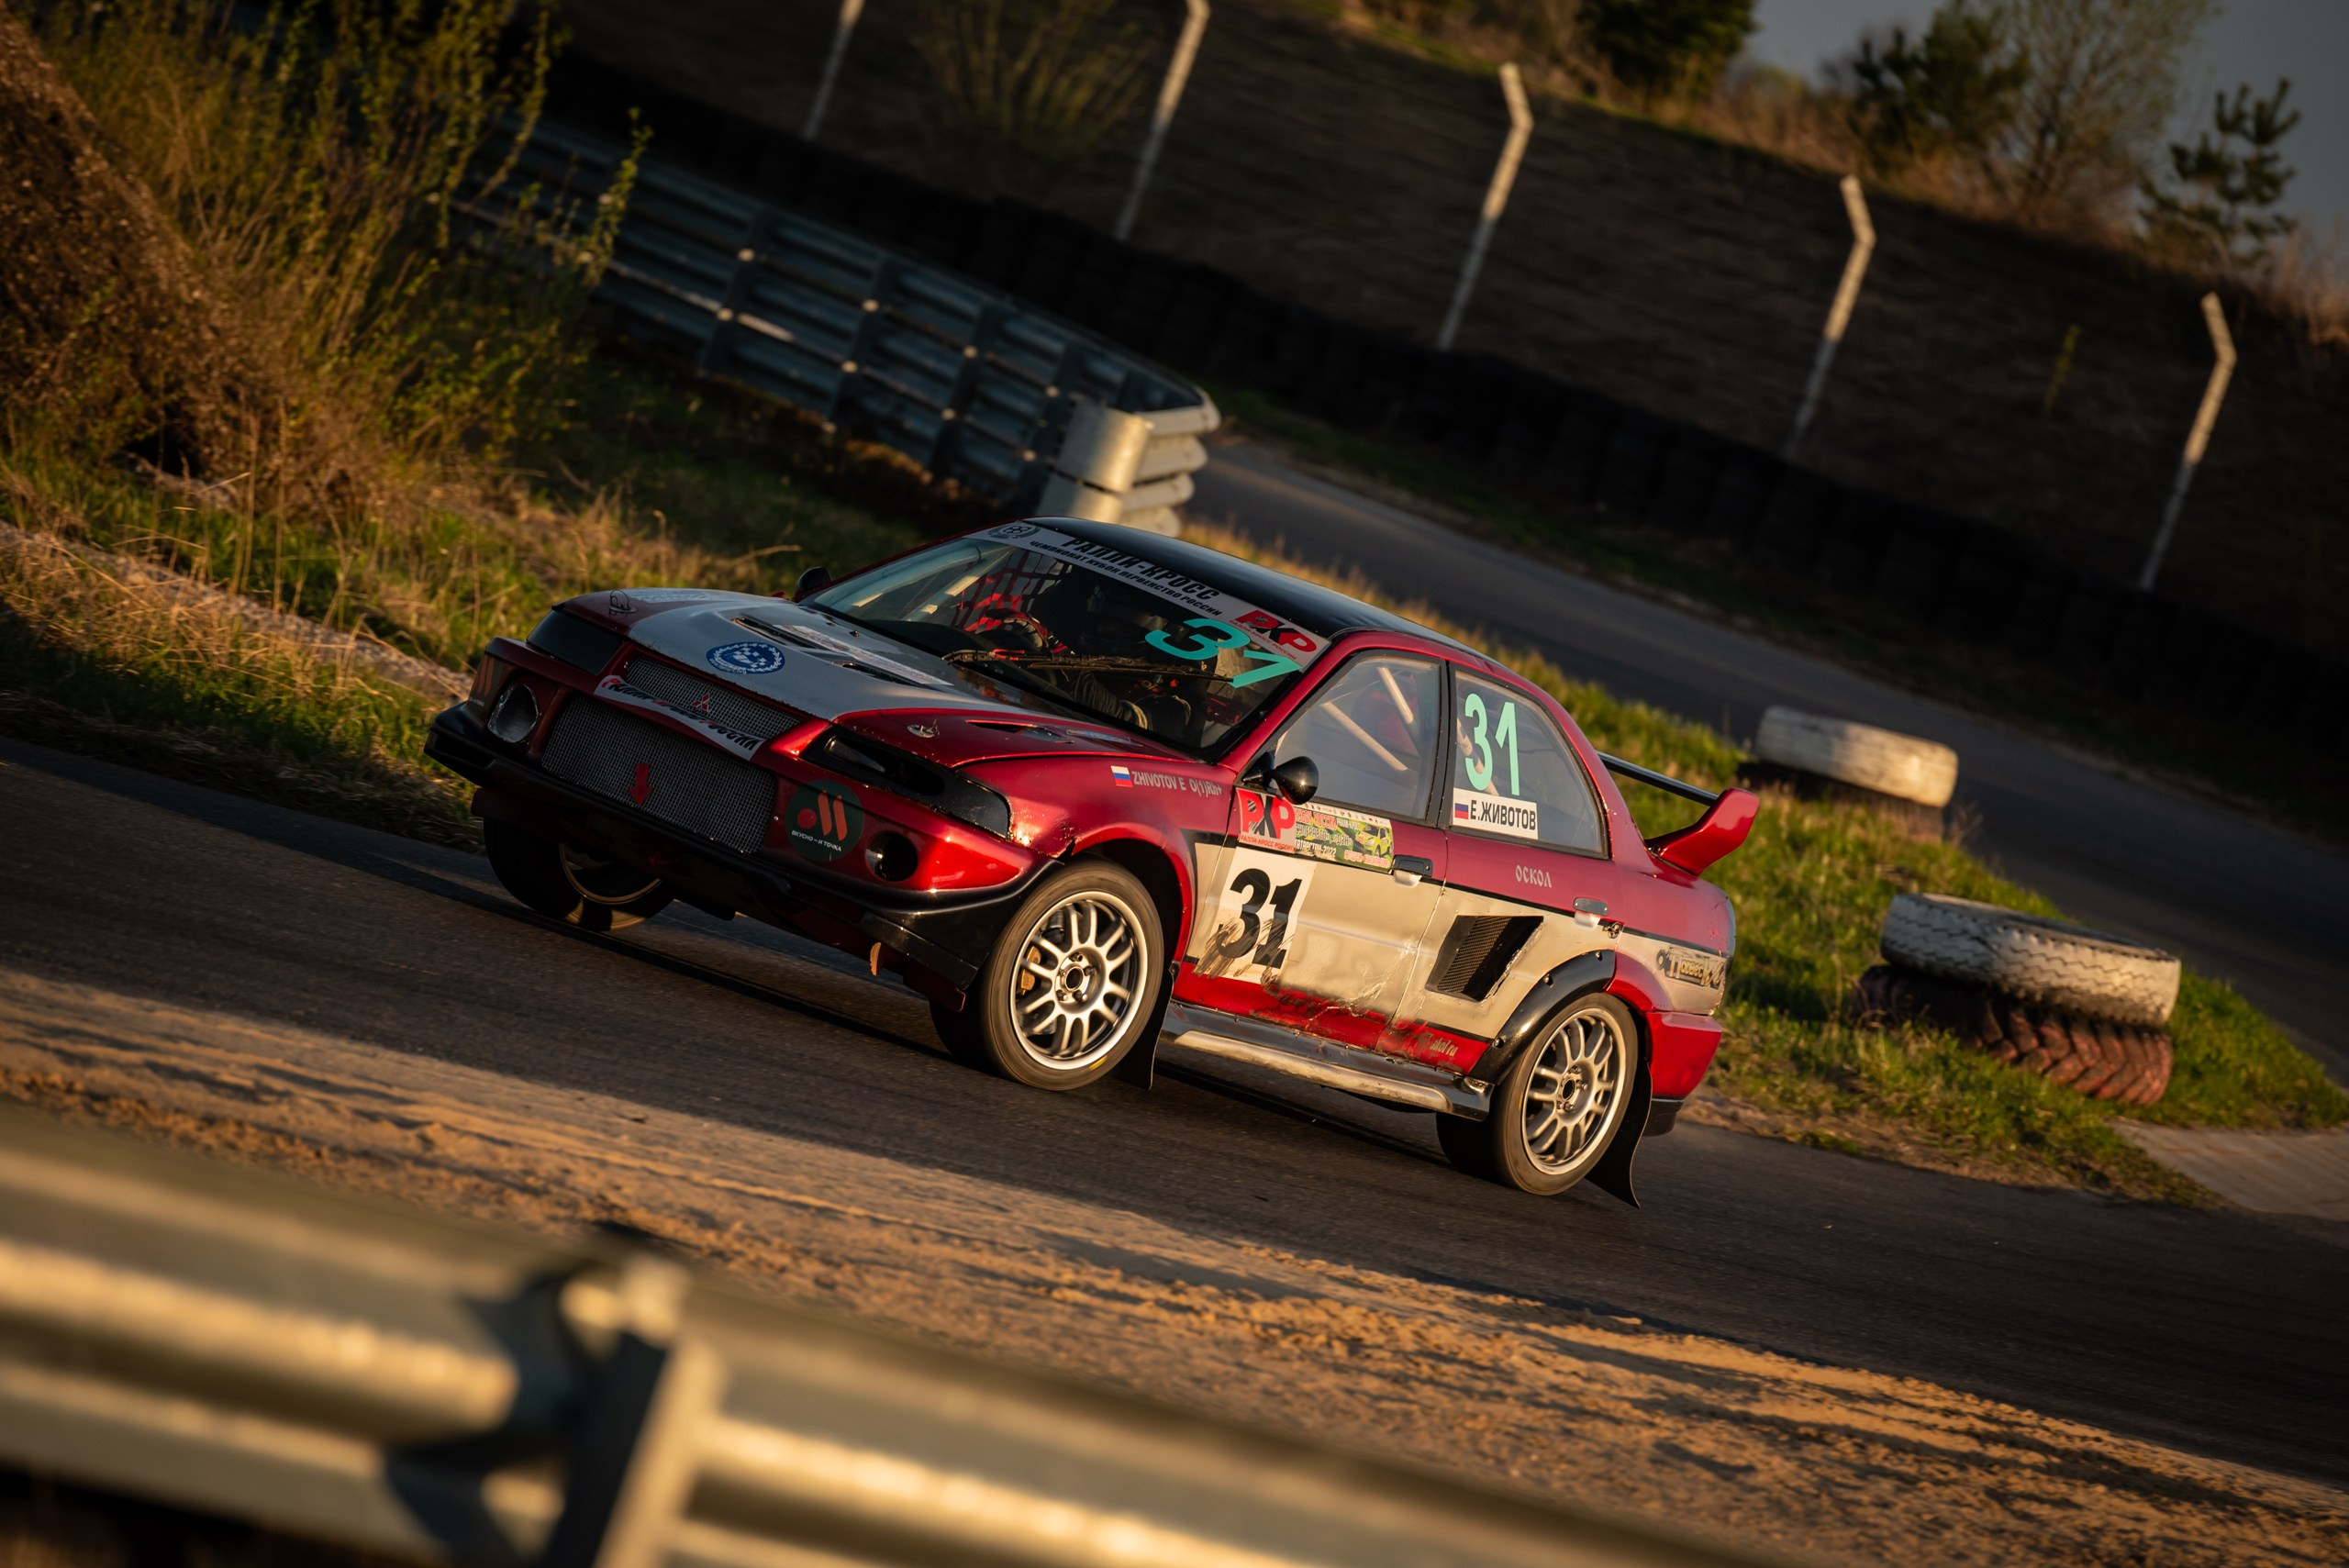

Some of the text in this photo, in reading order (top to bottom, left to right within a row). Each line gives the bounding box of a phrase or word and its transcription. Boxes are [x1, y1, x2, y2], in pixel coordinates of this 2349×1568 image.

[1030, 540, 1222, 616] ЧЕМПИОНАТ КУБОК ПЕРВЕНСТВО РОССИИ
[1061, 539, 1220, 600] РАЛЛИ-КРОСС
[1145, 617, 1303, 688] 31
[1465, 694, 1520, 796] 31
[1131, 771, 1177, 790] ZHIVOTOV
[1178, 777, 1186, 791] E
[1470, 800, 1536, 830] Е.ЖИВОТОВ
[791, 829, 814, 842] ВКУСНО
[823, 840, 842, 852] ТОЧКА
[1241, 835, 1274, 849] РАЛЛИ-КРОСС
[1516, 865, 1552, 888] ОСКОЛ
[1216, 868, 1302, 969] 31
